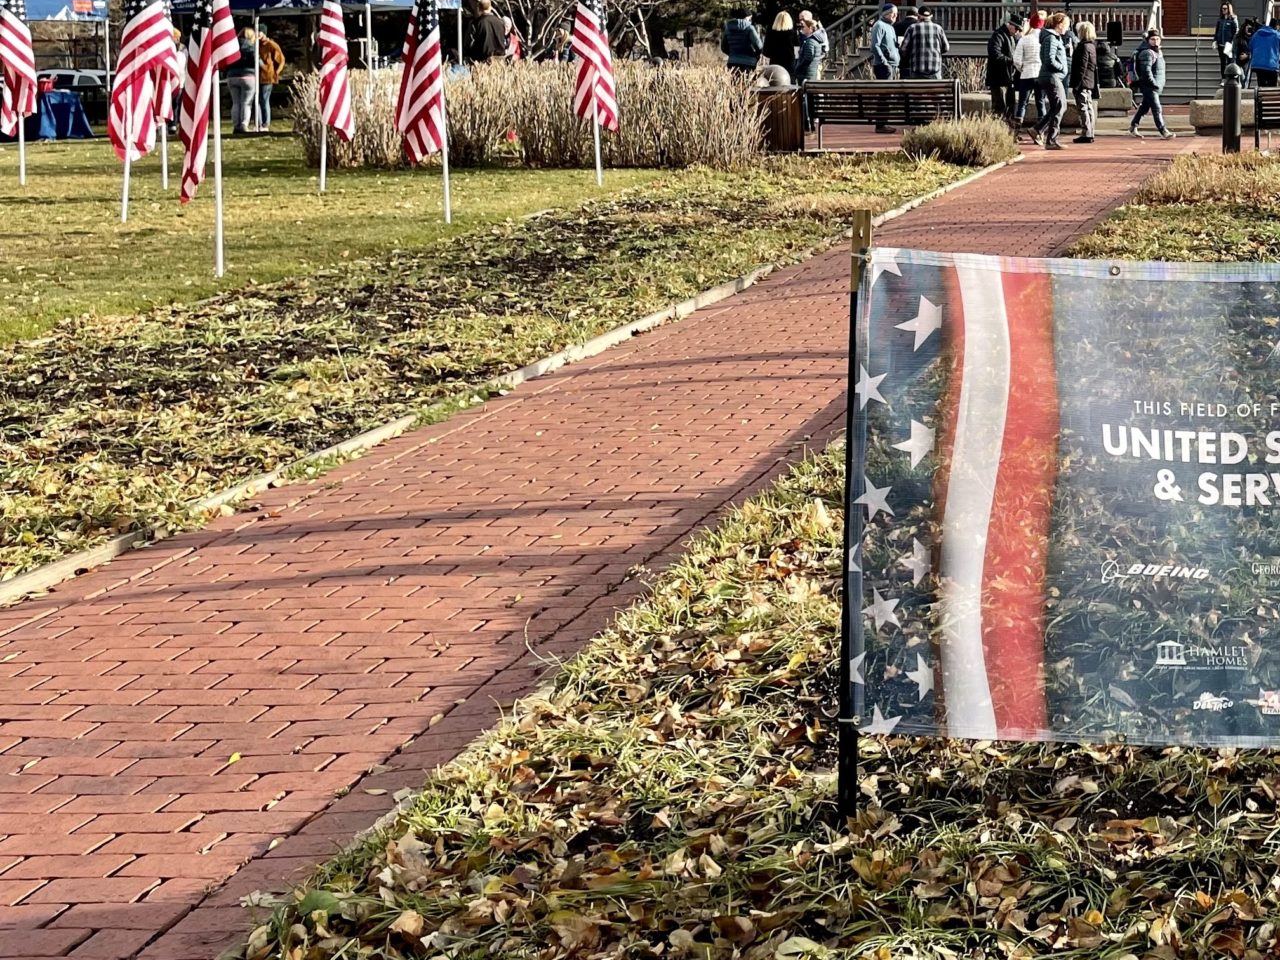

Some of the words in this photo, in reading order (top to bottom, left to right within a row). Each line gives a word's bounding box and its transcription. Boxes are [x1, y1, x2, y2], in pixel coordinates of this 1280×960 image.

[1134, 400, 1171, 415] THIS
[1181, 402, 1227, 417] FIELD
[1237, 403, 1261, 417] OF
[1102, 425, 1248, 464] UNITED
[1154, 468, 1184, 501] &
[1127, 563, 1210, 579] BOEING
[1189, 646, 1247, 657] HAMLET
[1206, 656, 1248, 665] HOMES
